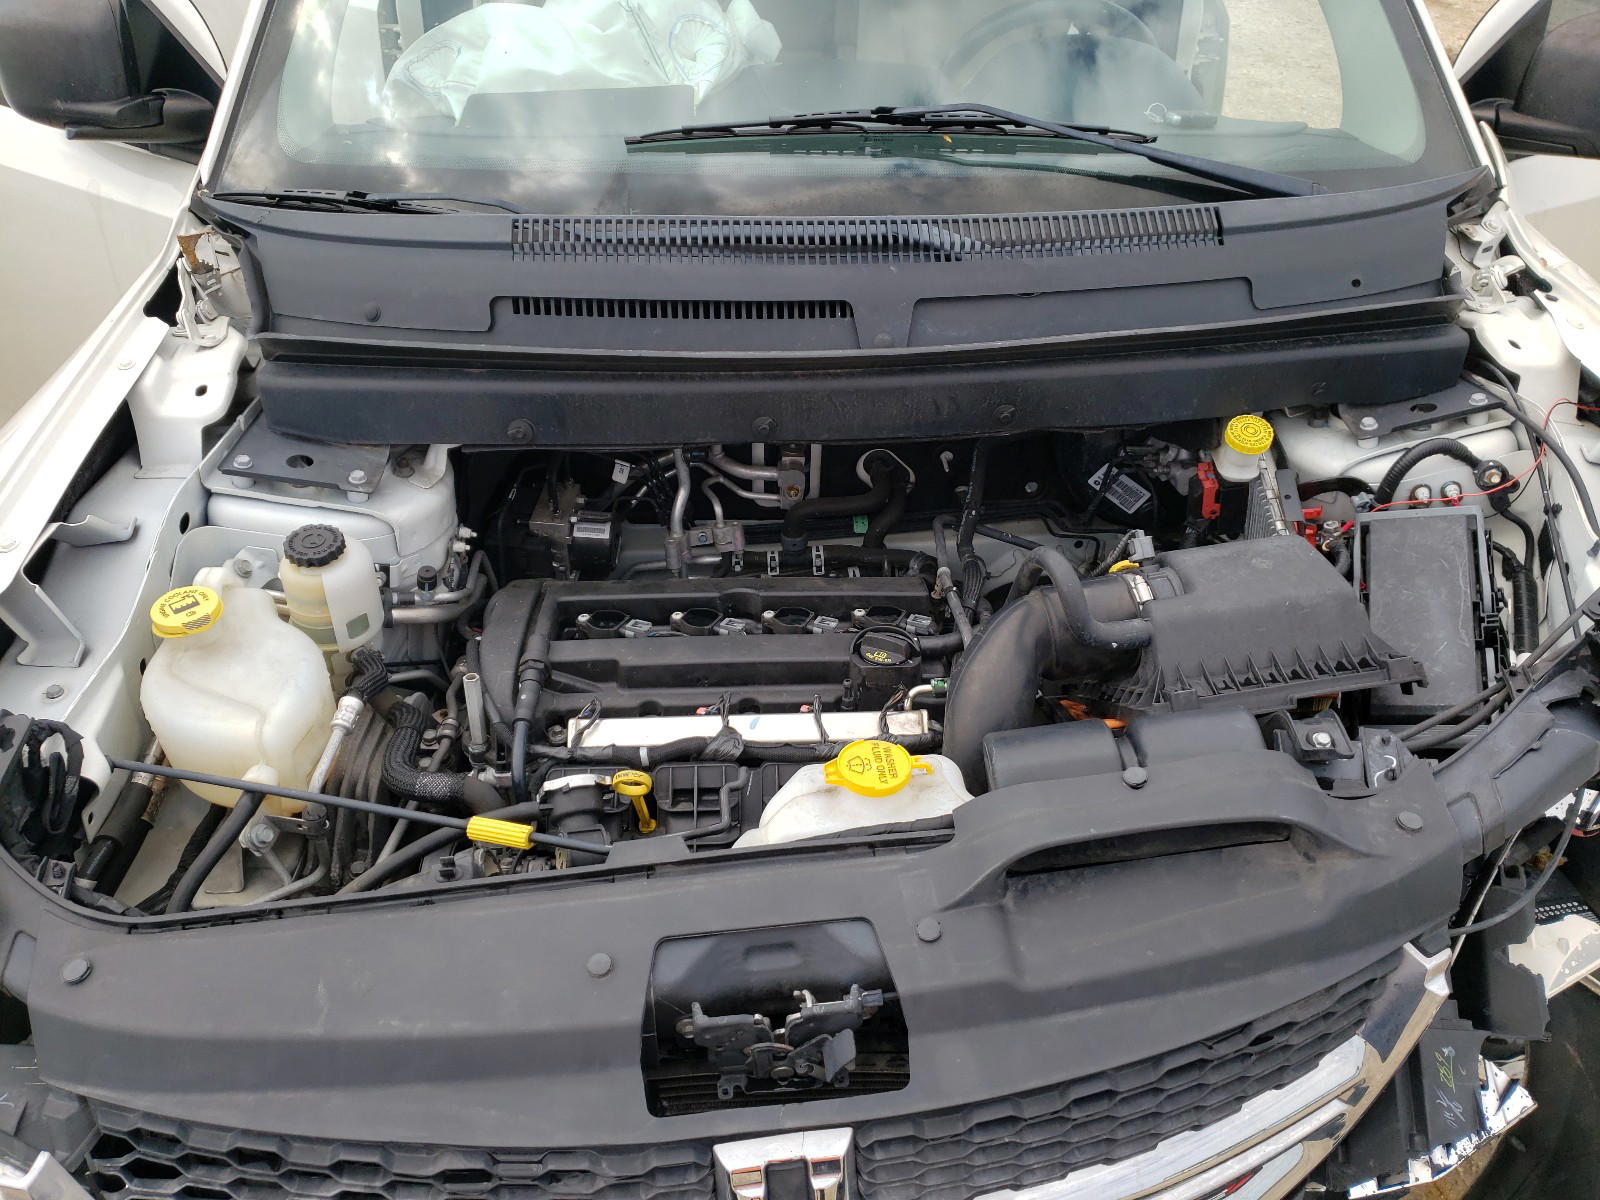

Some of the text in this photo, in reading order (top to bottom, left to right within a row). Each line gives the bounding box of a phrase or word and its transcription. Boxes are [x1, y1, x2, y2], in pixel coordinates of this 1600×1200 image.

[164, 589, 199, 603] COOLANT
[871, 742, 889, 784] FLUID ONLY
[882, 746, 898, 780] WASHER
